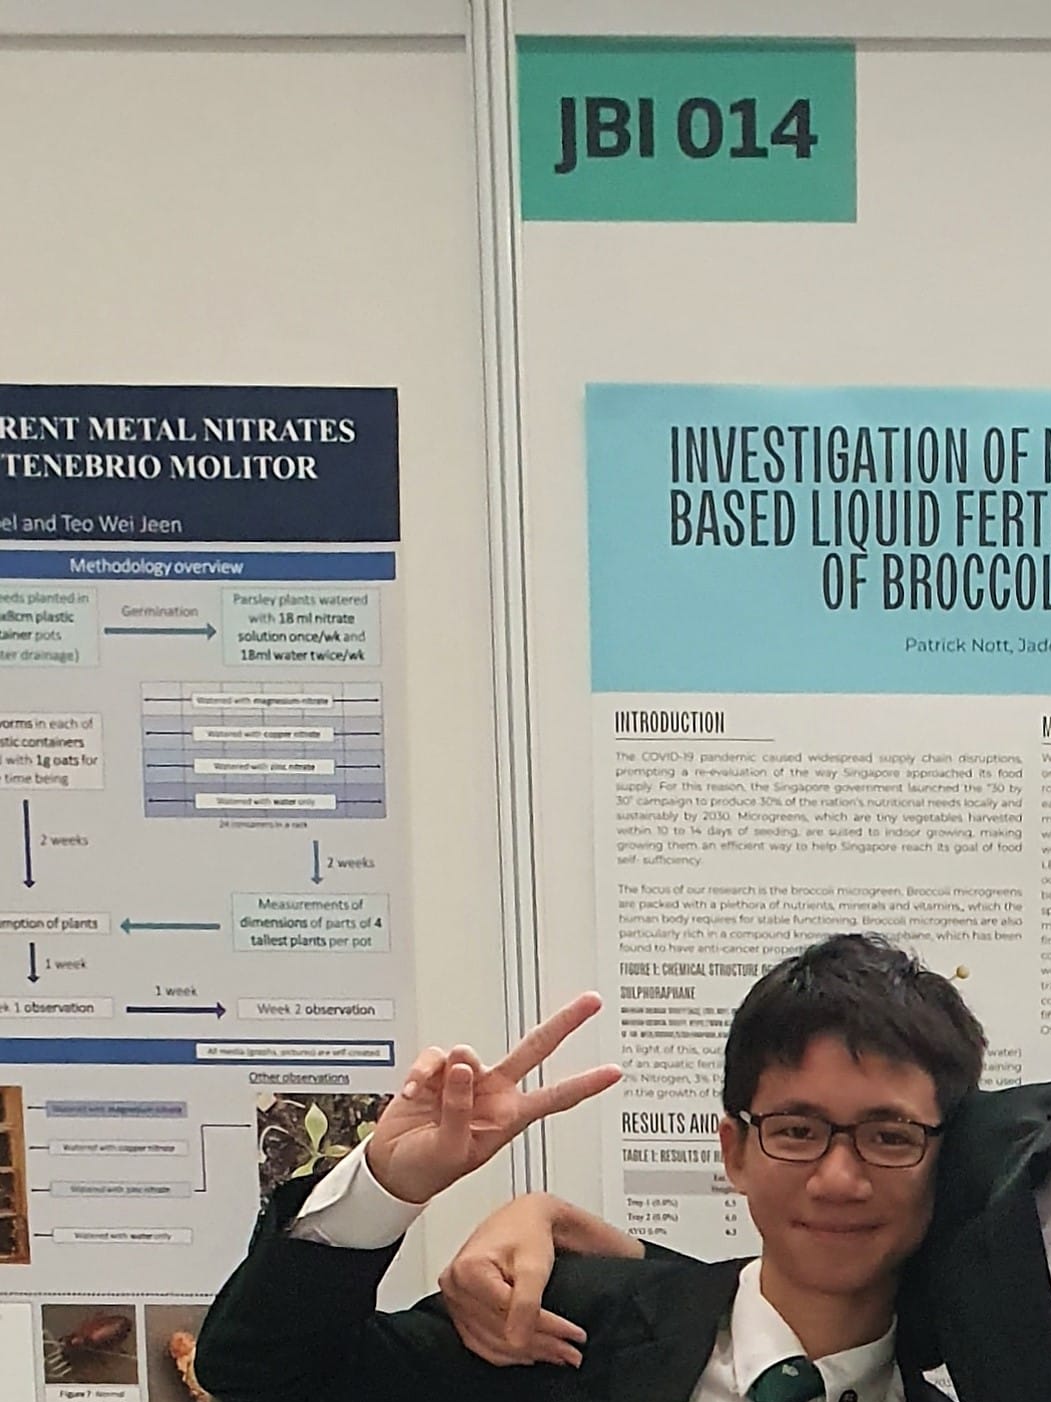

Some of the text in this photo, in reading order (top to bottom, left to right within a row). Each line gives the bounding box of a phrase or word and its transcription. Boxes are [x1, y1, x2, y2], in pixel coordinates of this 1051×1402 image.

[555, 97, 818, 174] JBI 014
[90, 418, 196, 440] METAL
[204, 419, 354, 441] NITRATES
[672, 426, 967, 484] INVESTIGATION
[984, 427, 1029, 484] OF
[1, 454, 316, 479] TENEBRIO MOLITOR
[23, 513, 182, 533] and Teo Wei Jeen
[671, 490, 795, 546] BASED
[812, 490, 939, 552] LIQUID
[71, 558, 243, 576] Methodology overview
[823, 550, 867, 610] OF
[279, 593, 316, 608] plants
[319, 593, 368, 605] watered
[121, 606, 198, 618] Germination
[249, 612, 355, 625] with 18 ml nitrate
[238, 630, 365, 645] solution once/wk and
[906, 638, 966, 653] Patrick
[972, 638, 1013, 655] Nott,
[616, 711, 724, 732] INTRODUCTION
[622, 1112, 719, 1133] RESULTS AND
